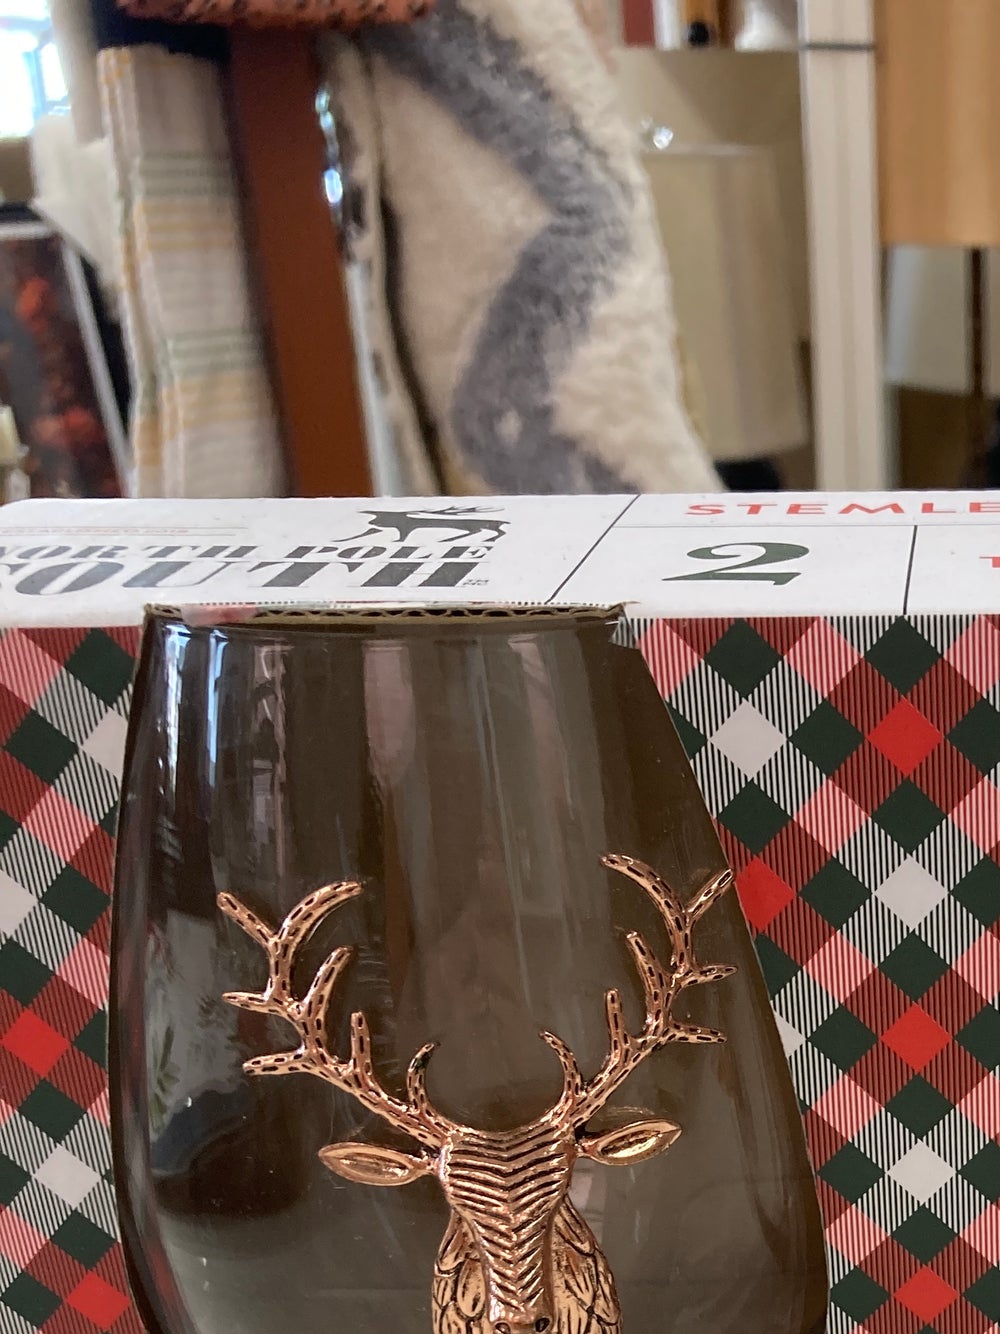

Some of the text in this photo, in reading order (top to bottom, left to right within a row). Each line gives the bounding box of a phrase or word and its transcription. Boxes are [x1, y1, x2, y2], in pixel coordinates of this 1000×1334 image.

[283, 545, 493, 559] POLE
[662, 542, 809, 586] 2
[0, 561, 489, 596] OUTH
